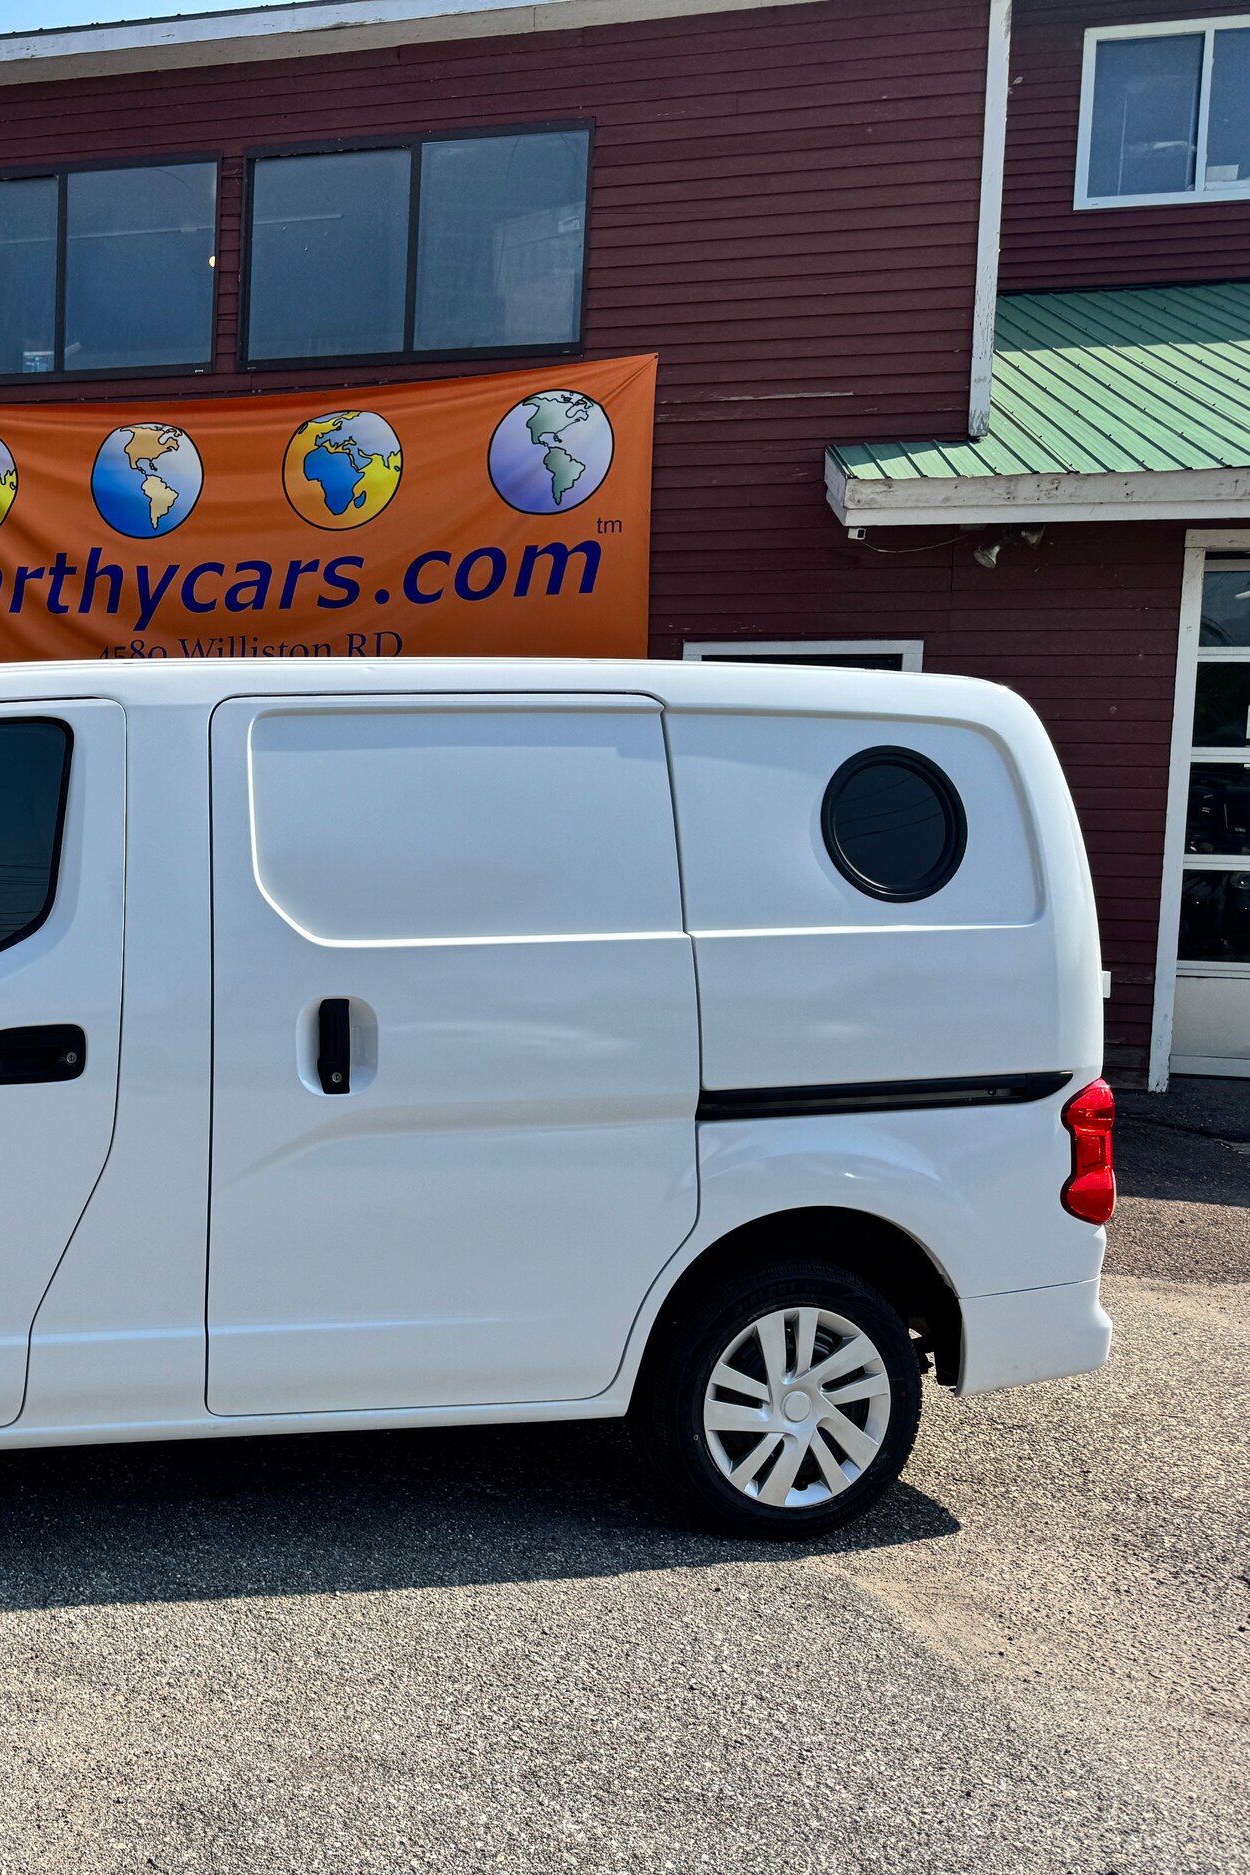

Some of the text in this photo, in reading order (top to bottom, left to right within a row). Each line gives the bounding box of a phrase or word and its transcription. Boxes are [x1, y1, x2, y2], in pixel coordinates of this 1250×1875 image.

[596, 516, 623, 534] tm
[176, 635, 331, 658] Williston
[346, 631, 403, 658] RD
